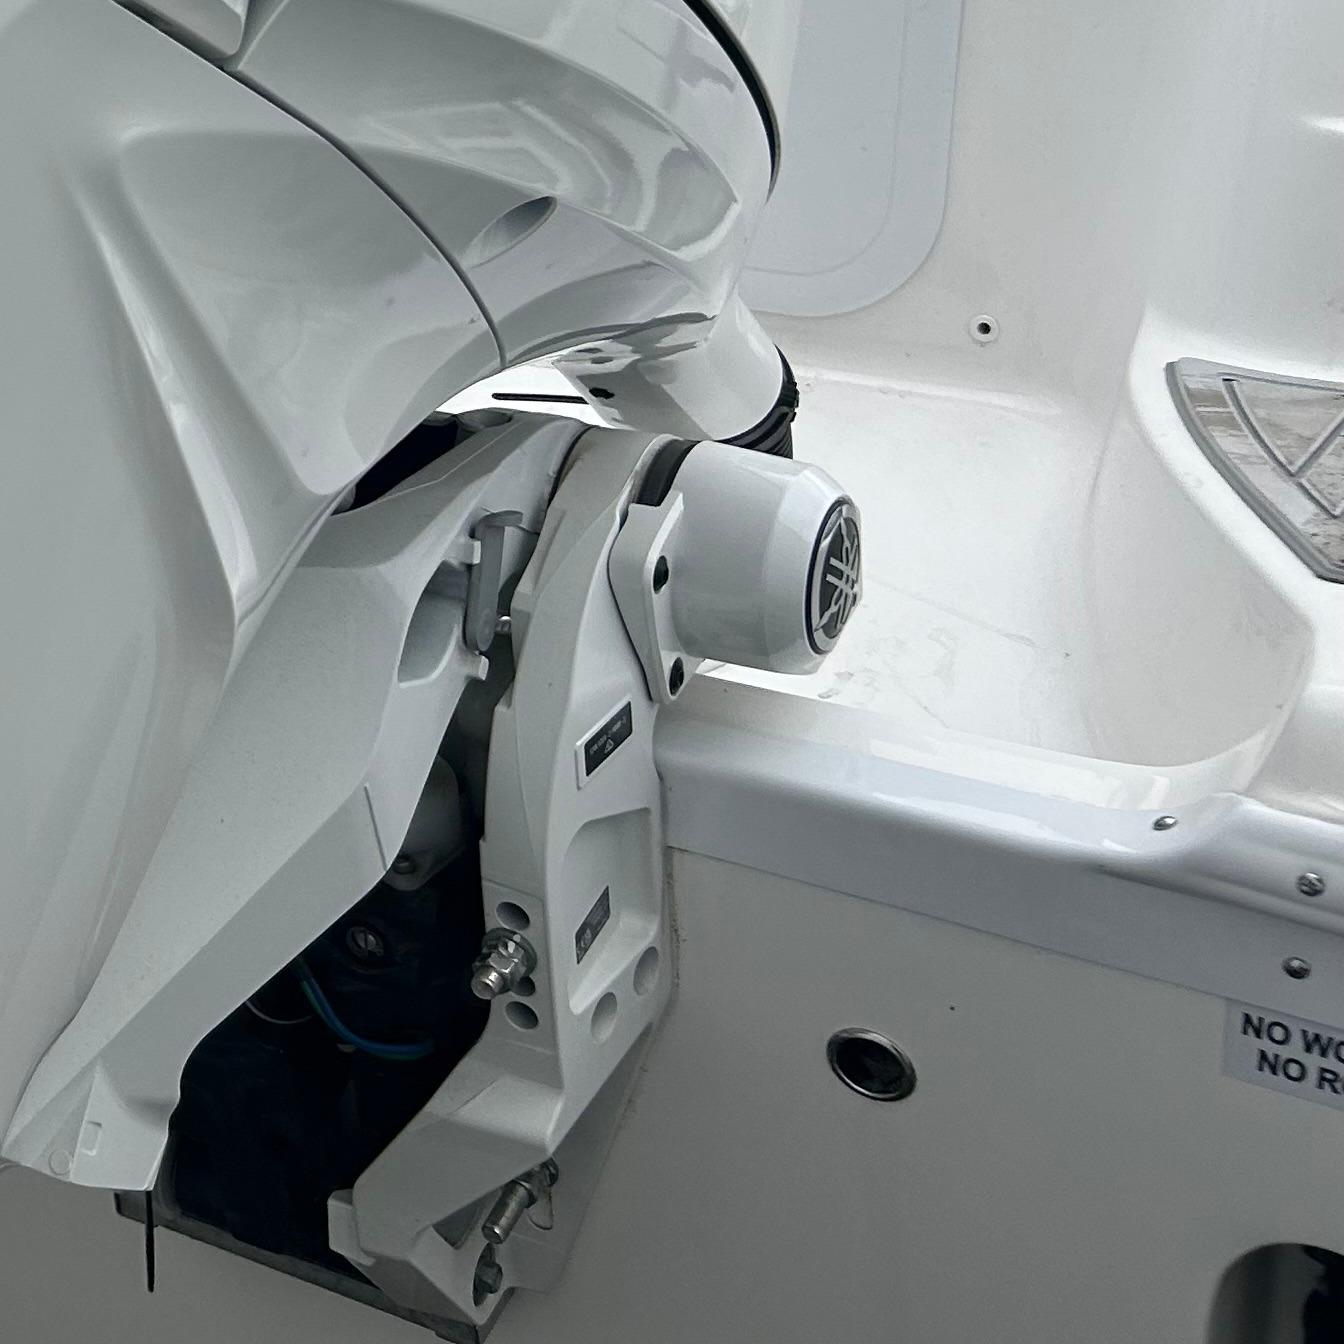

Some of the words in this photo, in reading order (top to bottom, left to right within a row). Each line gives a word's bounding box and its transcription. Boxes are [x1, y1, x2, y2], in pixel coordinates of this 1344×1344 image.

[1241, 1011, 1291, 1046] NO
[1256, 1048, 1307, 1083] NO
[1316, 1066, 1344, 1095] R
